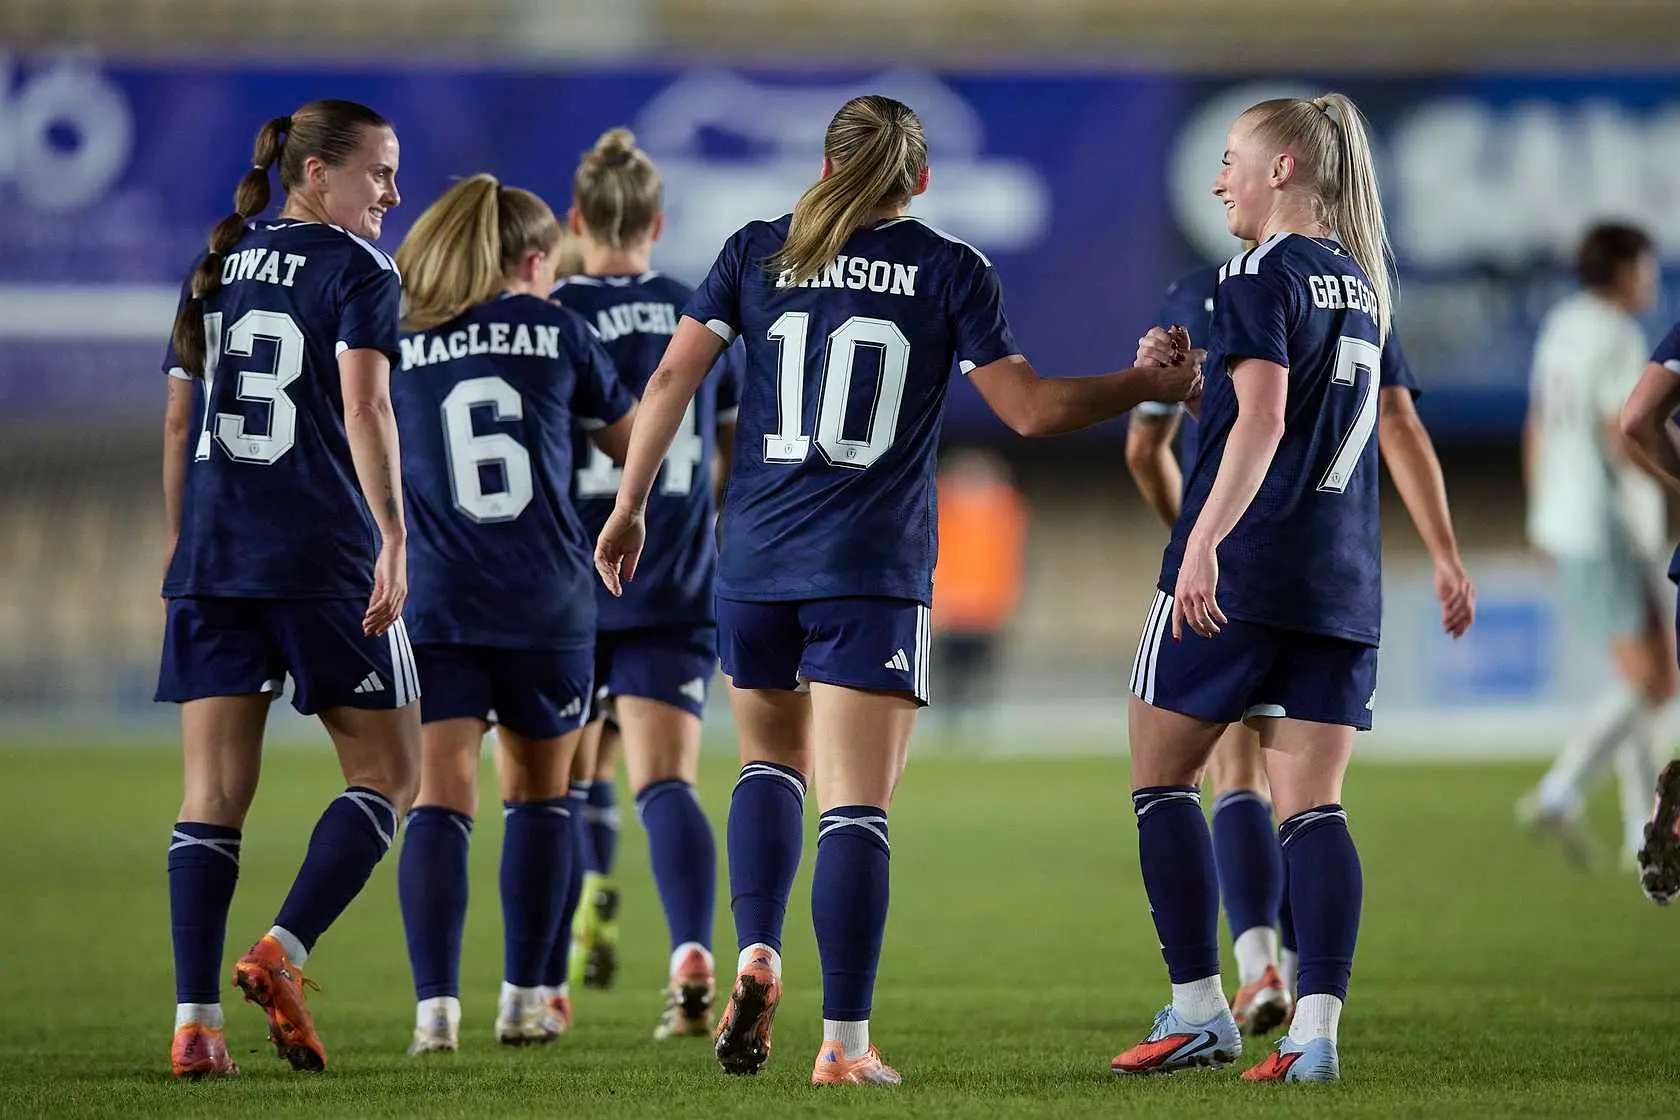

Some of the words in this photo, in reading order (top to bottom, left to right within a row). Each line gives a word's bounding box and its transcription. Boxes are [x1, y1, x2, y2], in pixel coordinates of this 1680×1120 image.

[221, 248, 307, 287] OWAT
[195, 311, 304, 464] 13
[400, 323, 560, 371] MACLEAN
[764, 312, 910, 470] 10
[1316, 336, 1381, 493] 7
[440, 376, 533, 523] 6
